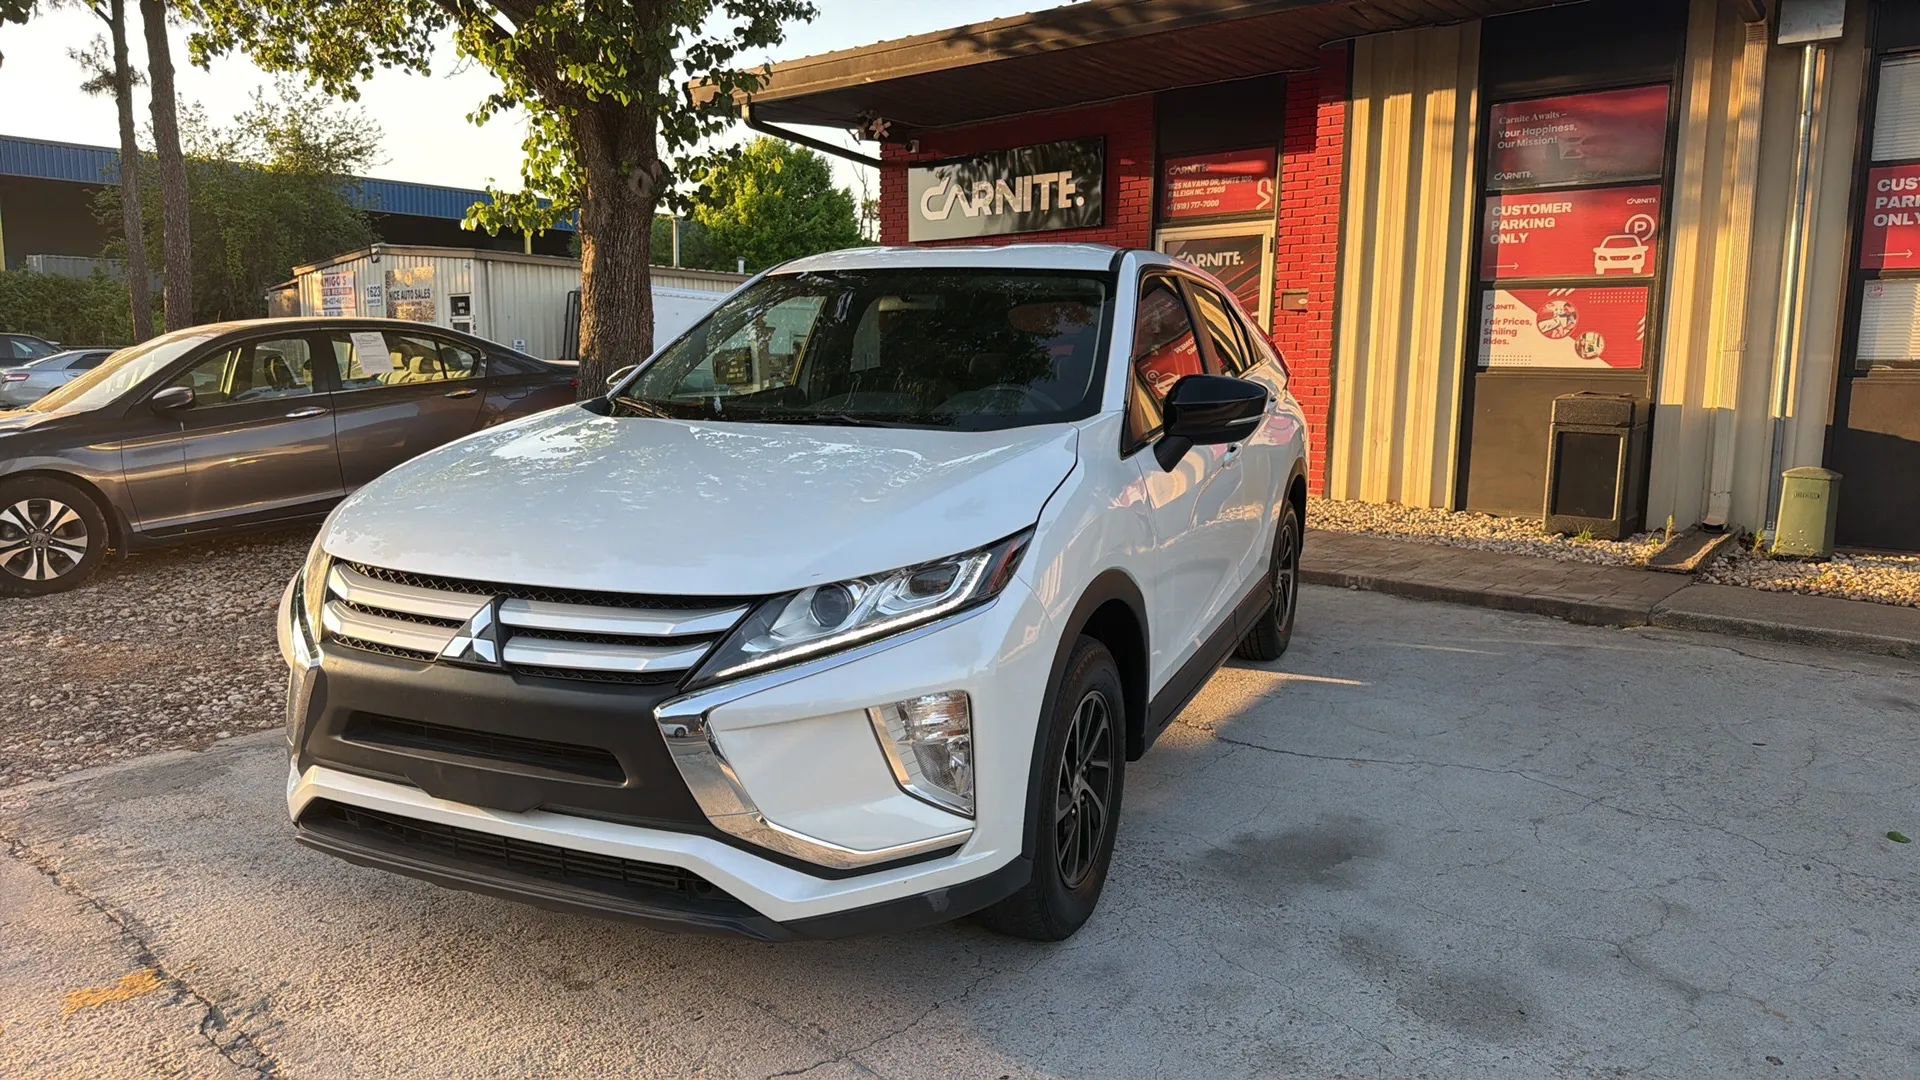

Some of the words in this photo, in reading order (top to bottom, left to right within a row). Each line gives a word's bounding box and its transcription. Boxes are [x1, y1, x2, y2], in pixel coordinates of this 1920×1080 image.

[1500, 115, 1529, 124] Carnite
[1531, 111, 1559, 121] Awaits
[1499, 129, 1520, 137] Your
[1522, 124, 1578, 136] Happiness,
[1497, 140, 1515, 149] Our
[1517, 136, 1557, 147] Mission!
[1877, 177, 1920, 192] CUS
[1492, 202, 1572, 216] CUSTOMER
[1491, 217, 1555, 232] PARKING
[1490, 232, 1529, 245] ONLY
[1176, 251, 1244, 267] ARNITE.
[366, 286, 381, 297] 1623
[400, 289, 414, 300] AUTO
[414, 288, 431, 300] SALES
[1484, 318, 1501, 326] Fair
[1502, 318, 1532, 326] Prices,
[1484, 328, 1517, 337] Smiling
